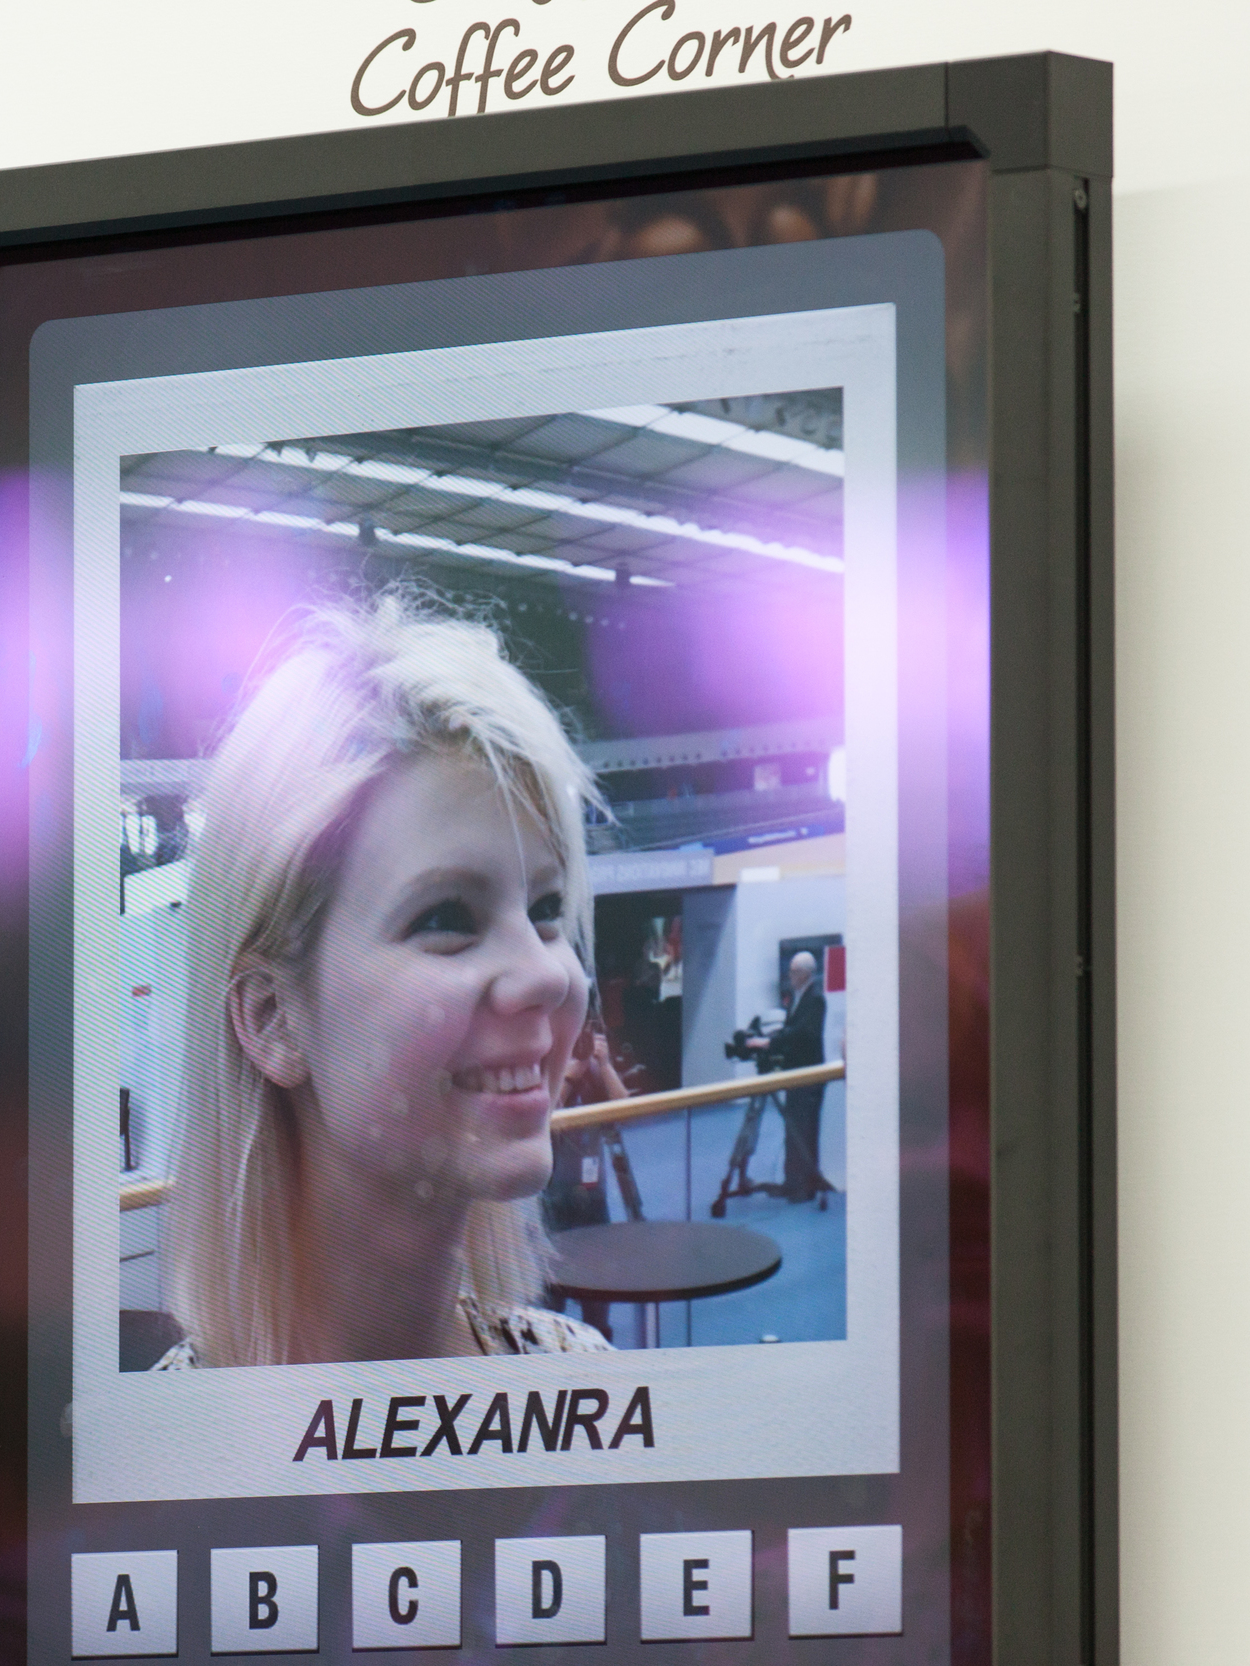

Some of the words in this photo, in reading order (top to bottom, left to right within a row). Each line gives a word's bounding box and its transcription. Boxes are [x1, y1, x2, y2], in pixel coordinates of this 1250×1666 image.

[350, 18, 575, 117] Coffee
[607, 0, 852, 87] Corner
[292, 1386, 655, 1462] ALEXANRA
[106, 1574, 141, 1632] A
[249, 1571, 279, 1630] B
[388, 1566, 419, 1626] C
[531, 1560, 564, 1619] D
[682, 1559, 711, 1617] E
[828, 1550, 856, 1611] F
